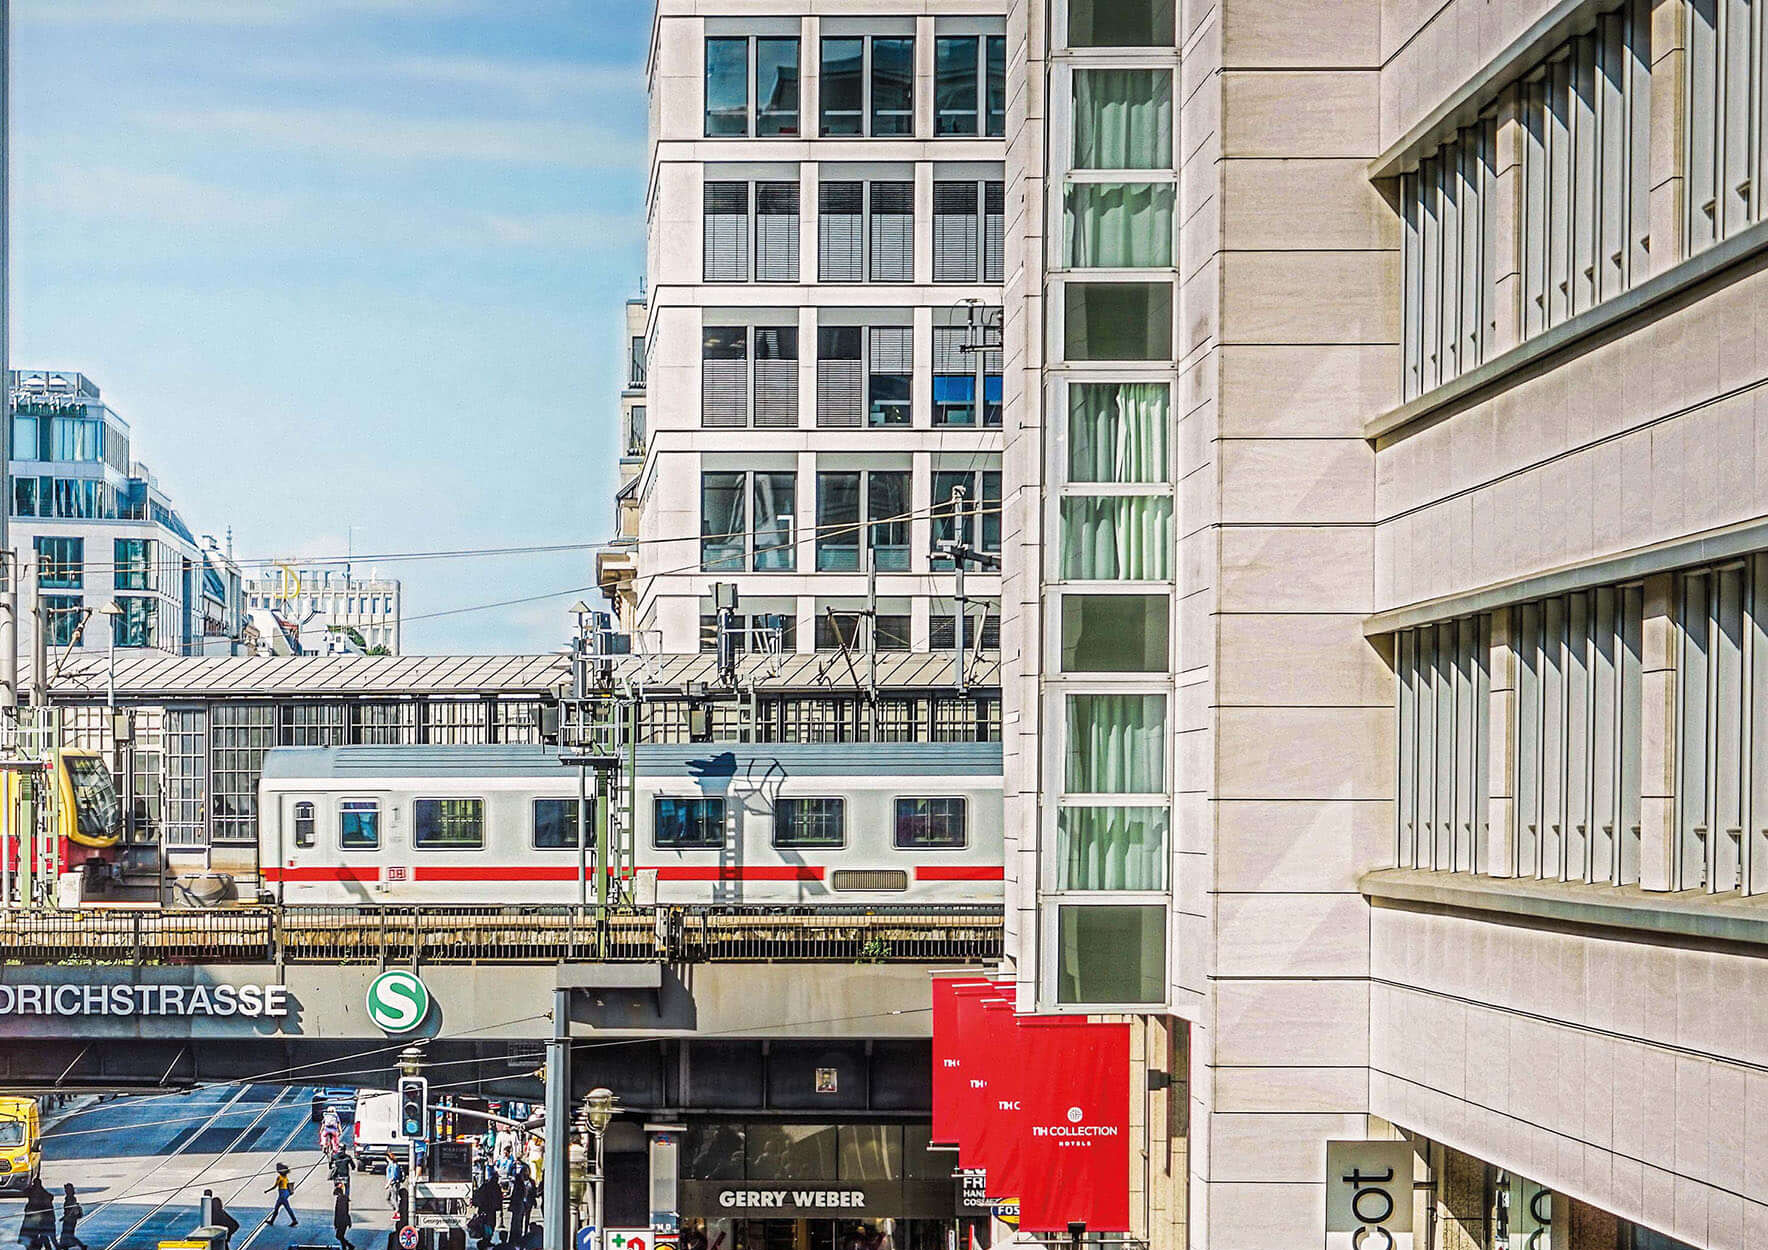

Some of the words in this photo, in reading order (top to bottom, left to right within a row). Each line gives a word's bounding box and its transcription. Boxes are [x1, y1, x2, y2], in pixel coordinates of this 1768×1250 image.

[376, 975, 418, 1028] S
[1049, 1126, 1118, 1136] COLLECTION
[719, 1191, 788, 1208] GERRY
[792, 1191, 865, 1208] WEBER
